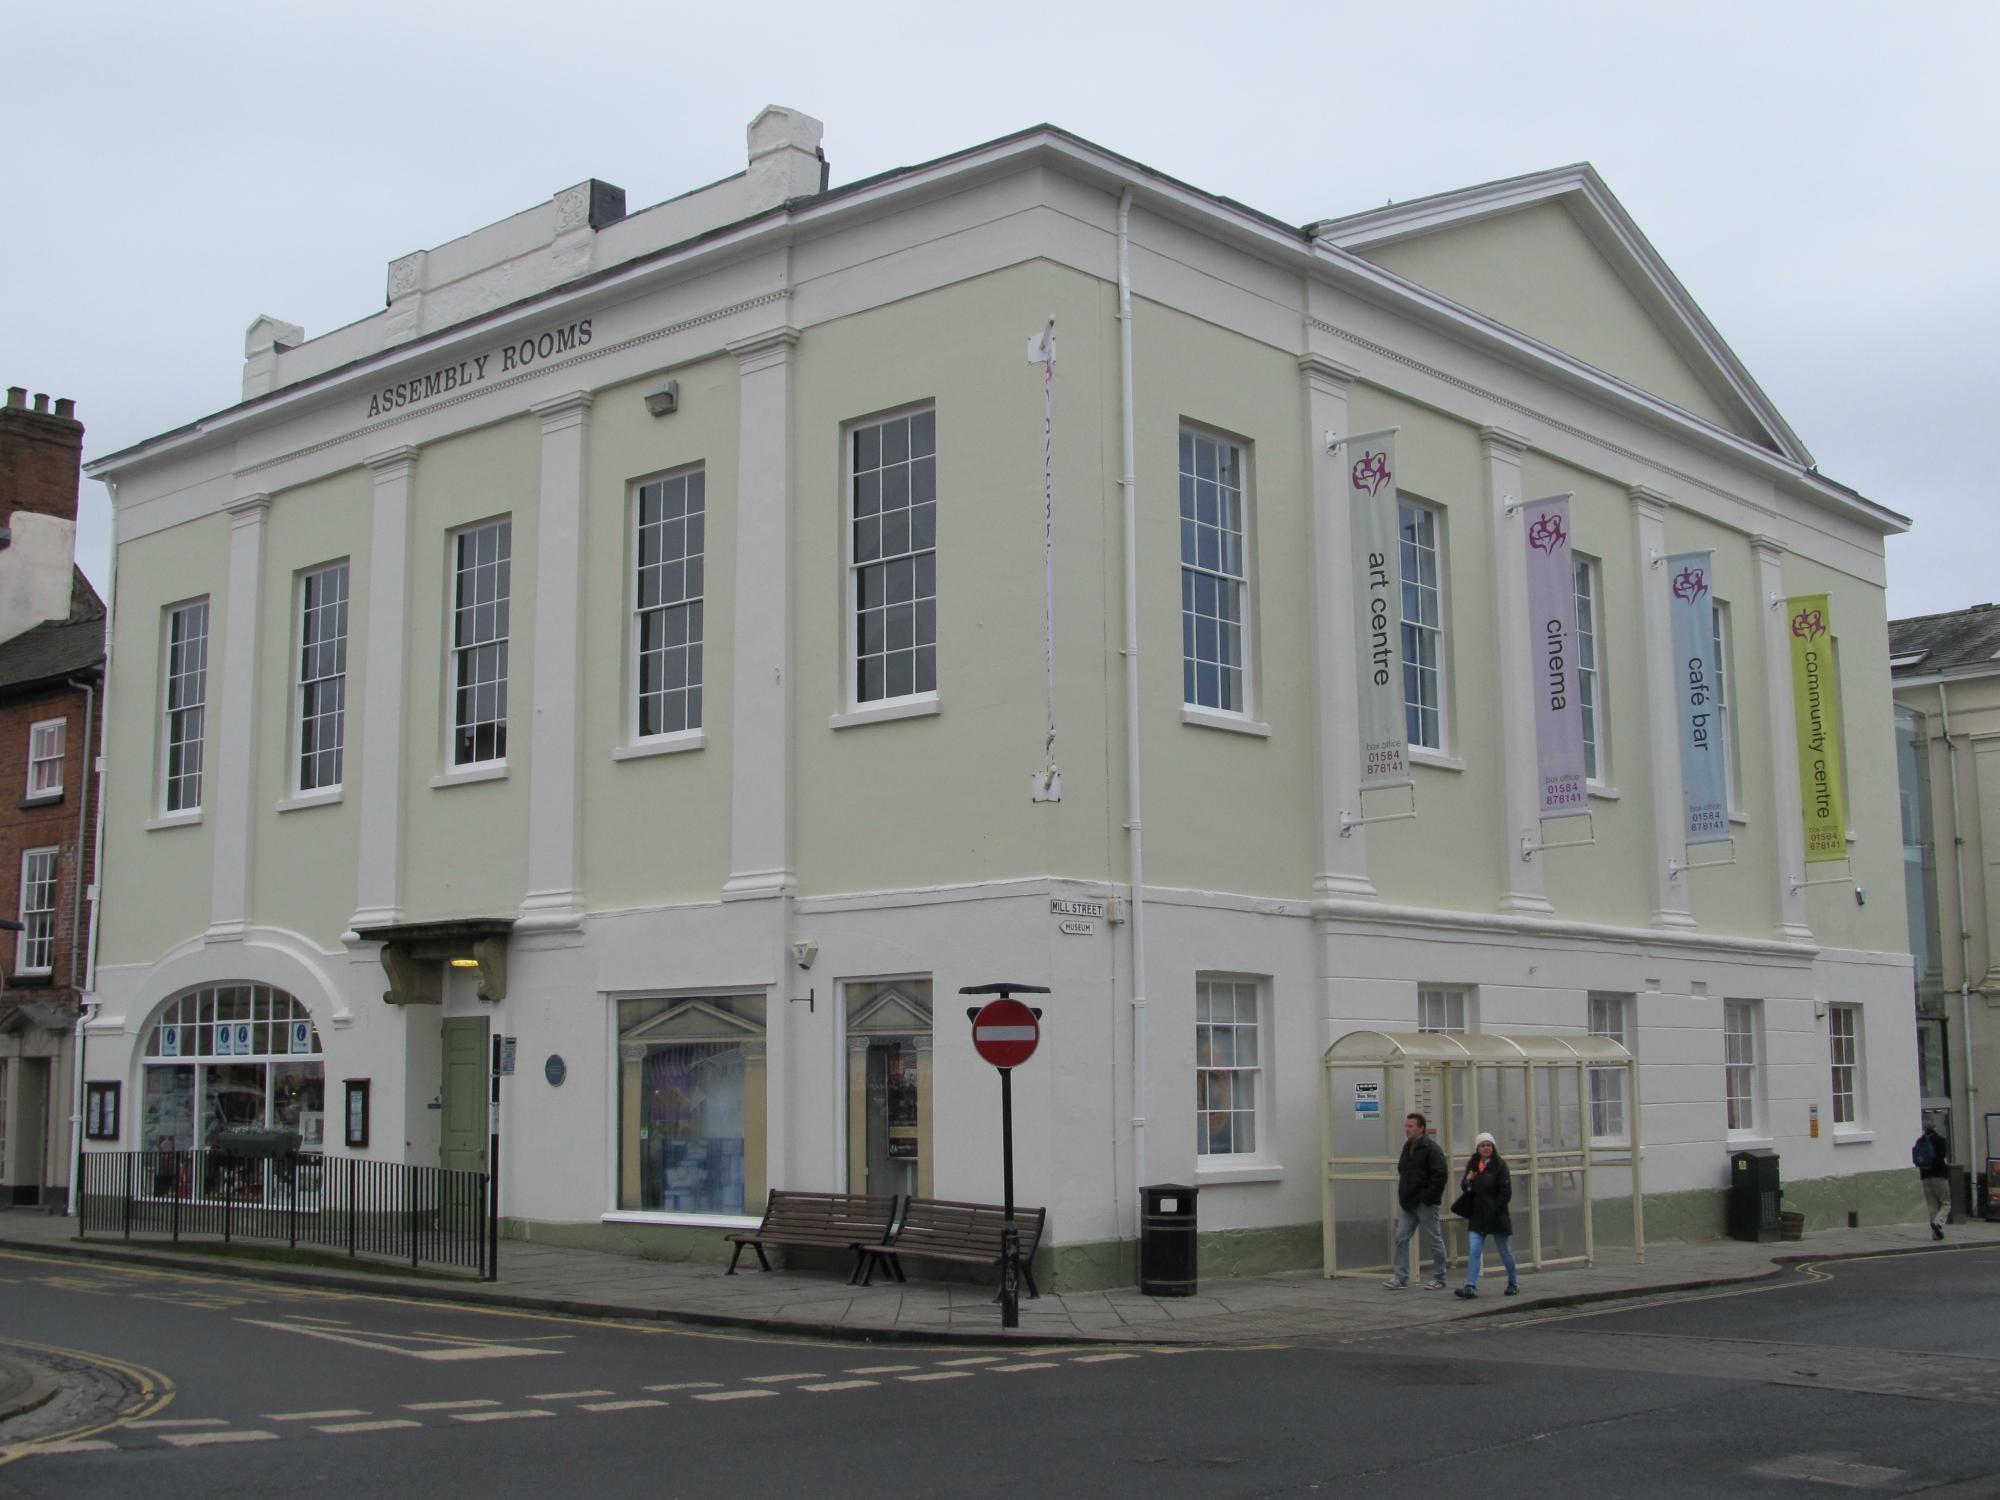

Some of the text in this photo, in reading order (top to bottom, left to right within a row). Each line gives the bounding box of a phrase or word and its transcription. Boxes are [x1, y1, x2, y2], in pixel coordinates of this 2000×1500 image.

[367, 319, 593, 418] ASSEMBLY ROOMS
[1368, 553, 1393, 686] art centre
[1546, 619, 1567, 711] cinema
[1688, 657, 1711, 751] café bar
[1805, 651, 1827, 753] community
[1368, 750, 1400, 762] 01584
[1367, 761, 1403, 774] 878141
[1547, 782, 1578, 794] 01584
[1813, 759, 1831, 819] centre
[1546, 793, 1581, 805] 878141
[1691, 820, 1724, 832] 878141
[1052, 901, 1102, 915] MILL STREET
[1065, 923, 1091, 932] MUSEUM
